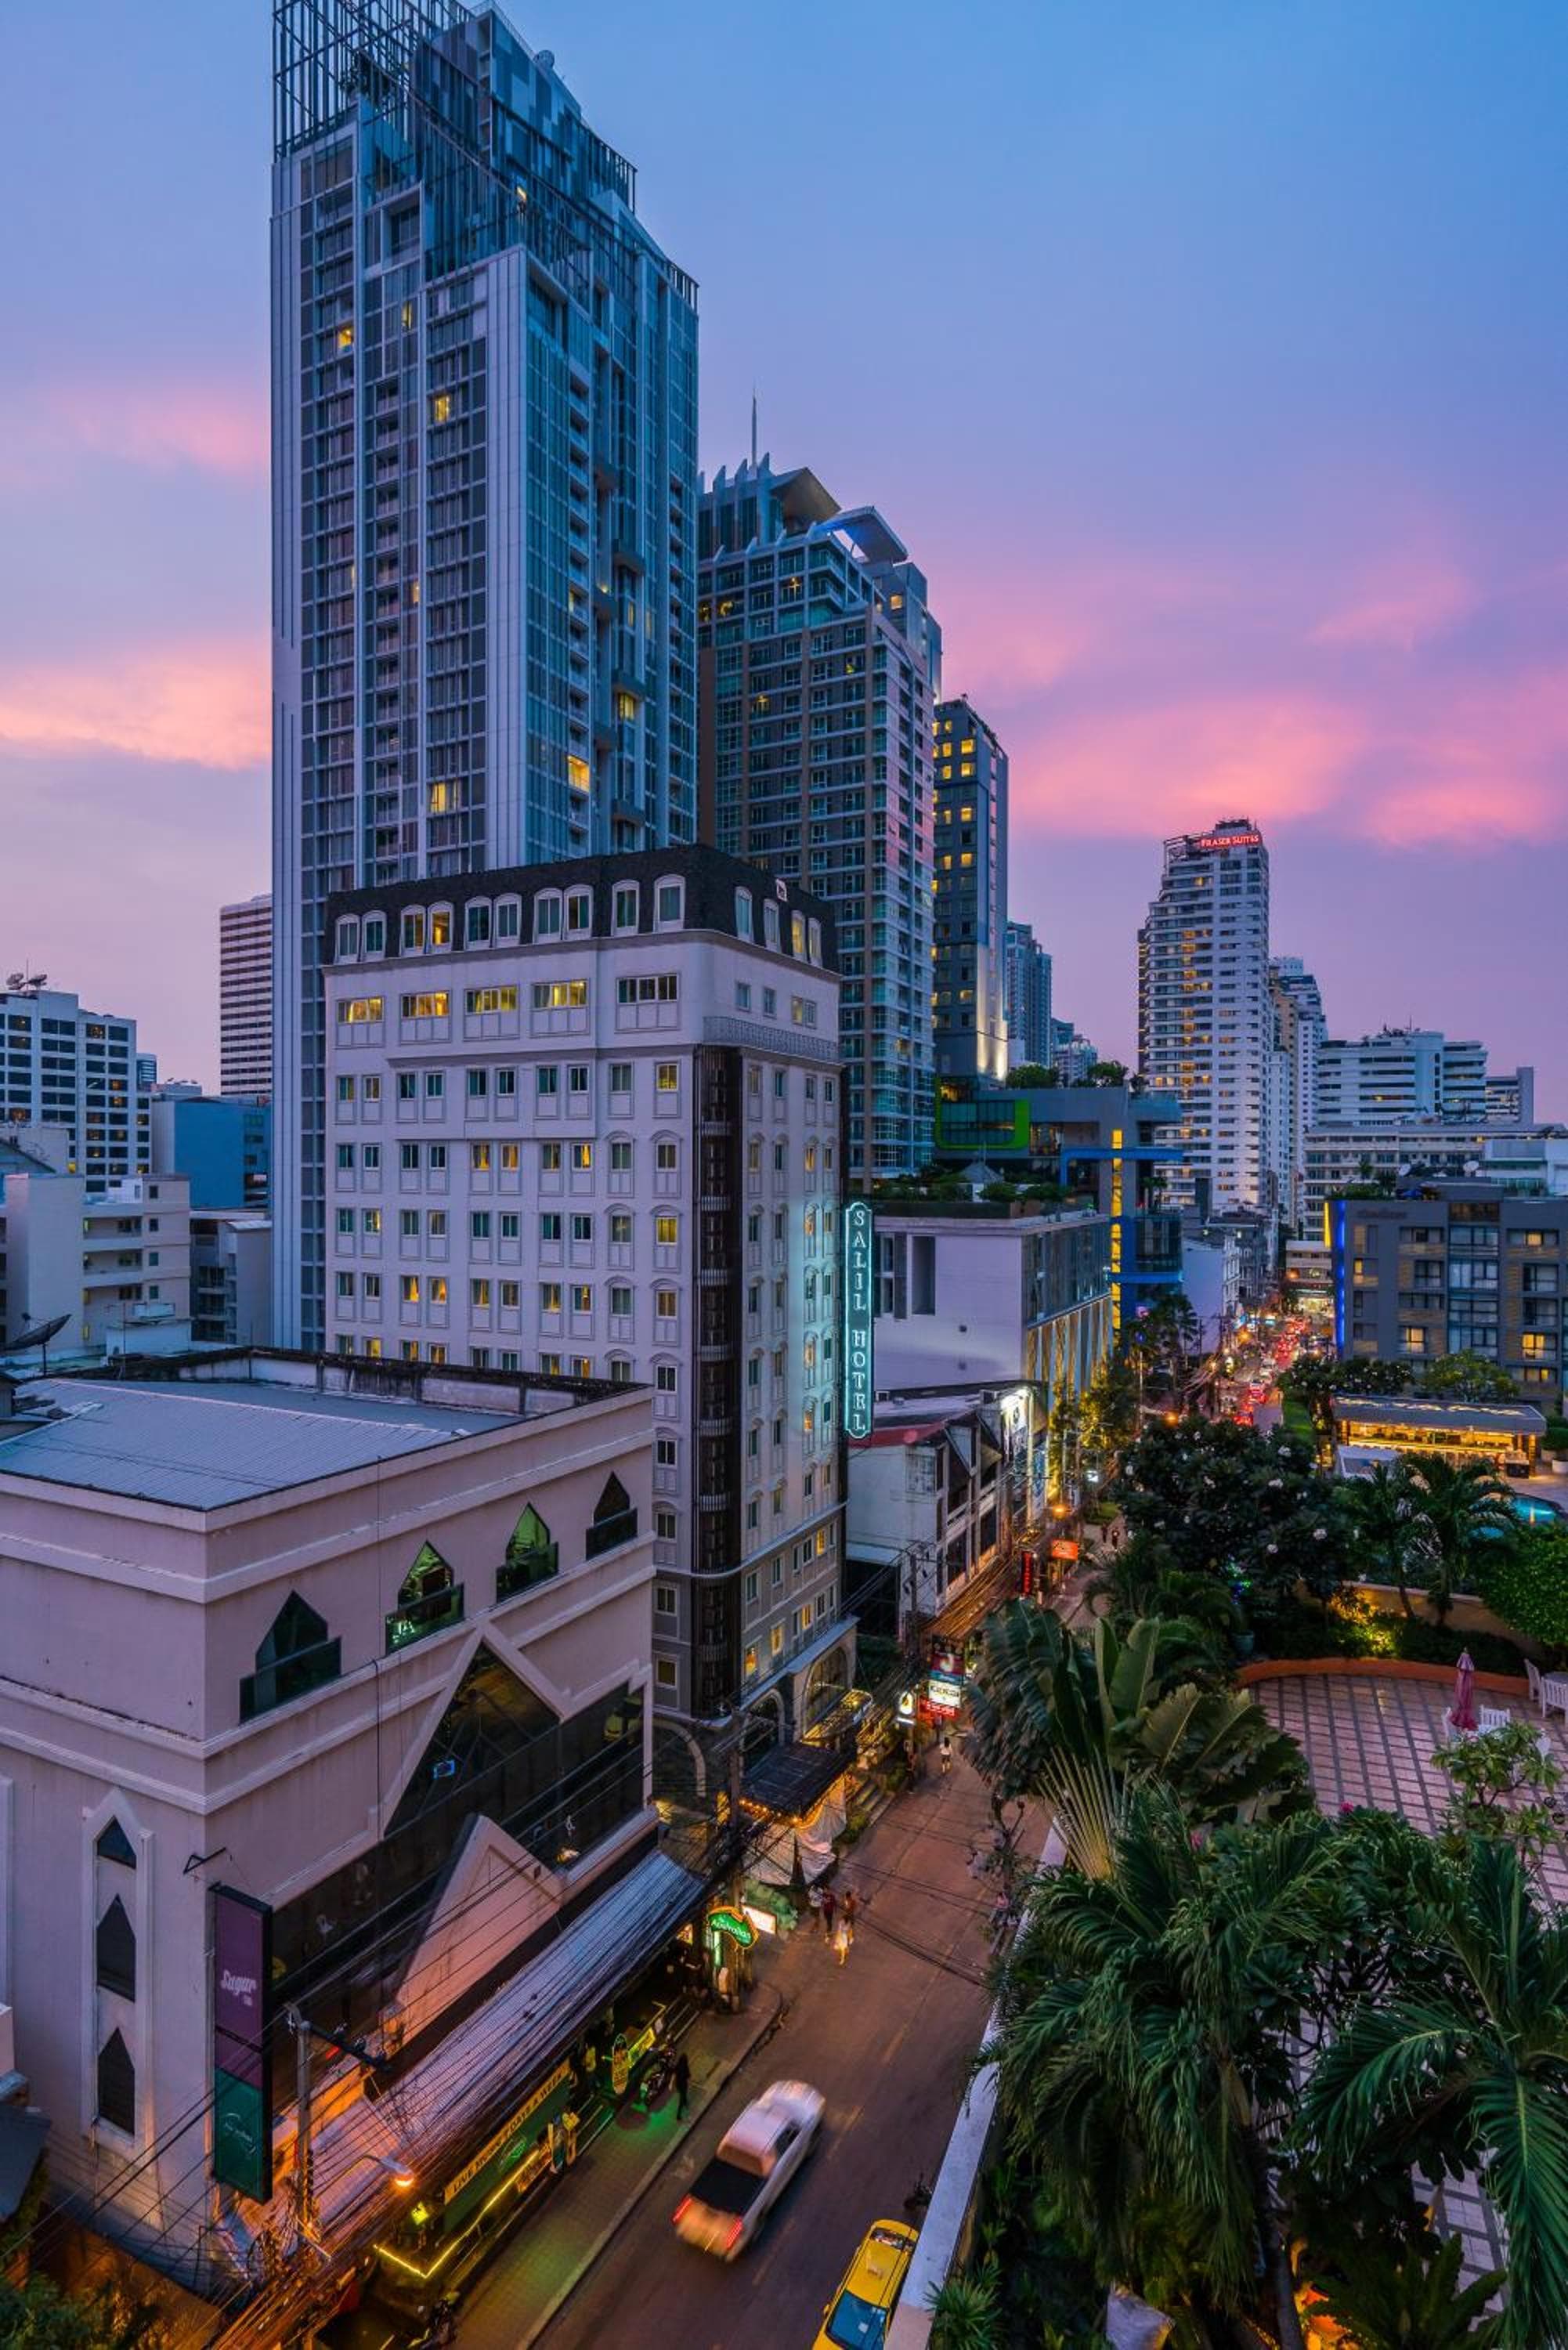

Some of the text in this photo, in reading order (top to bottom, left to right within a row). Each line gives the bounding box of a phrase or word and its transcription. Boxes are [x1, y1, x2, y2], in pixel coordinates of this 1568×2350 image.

[1201, 835, 1259, 847] FRASER SUITES
[852, 1211, 867, 1430] SALIL HOTEL
[453, 2167, 475, 2193] LIVE
